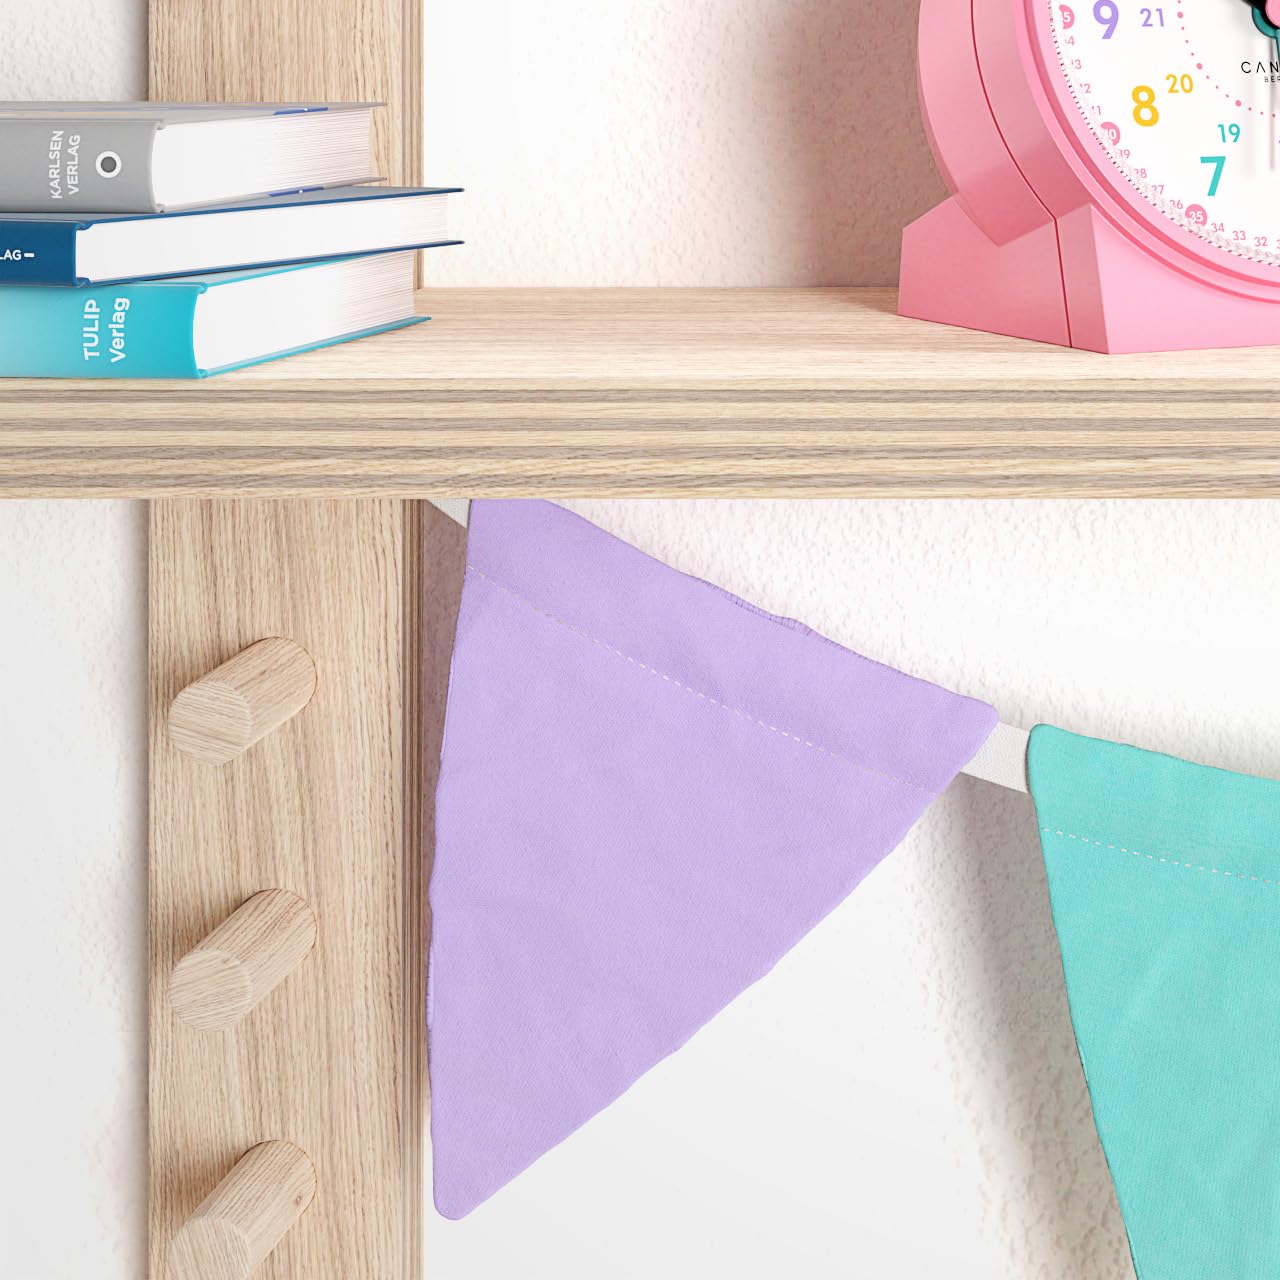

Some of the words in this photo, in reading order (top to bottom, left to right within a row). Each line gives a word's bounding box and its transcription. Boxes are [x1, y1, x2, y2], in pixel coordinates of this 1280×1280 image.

[1093, 0, 1119, 40] 9
[1140, 8, 1165, 27] 21
[1165, 73, 1193, 94] 20
[1132, 85, 1159, 127] 8
[1218, 123, 1241, 143] 19
[49, 130, 64, 199] KARLSEN
[67, 134, 81, 195] VERLAG
[1200, 156, 1226, 196] 7
[1211, 223, 1225, 233] 34
[1232, 231, 1246, 241] 33
[1254, 237, 1268, 247] 32
[83, 299, 100, 360] TULIP
[108, 297, 130, 363] Verlag
